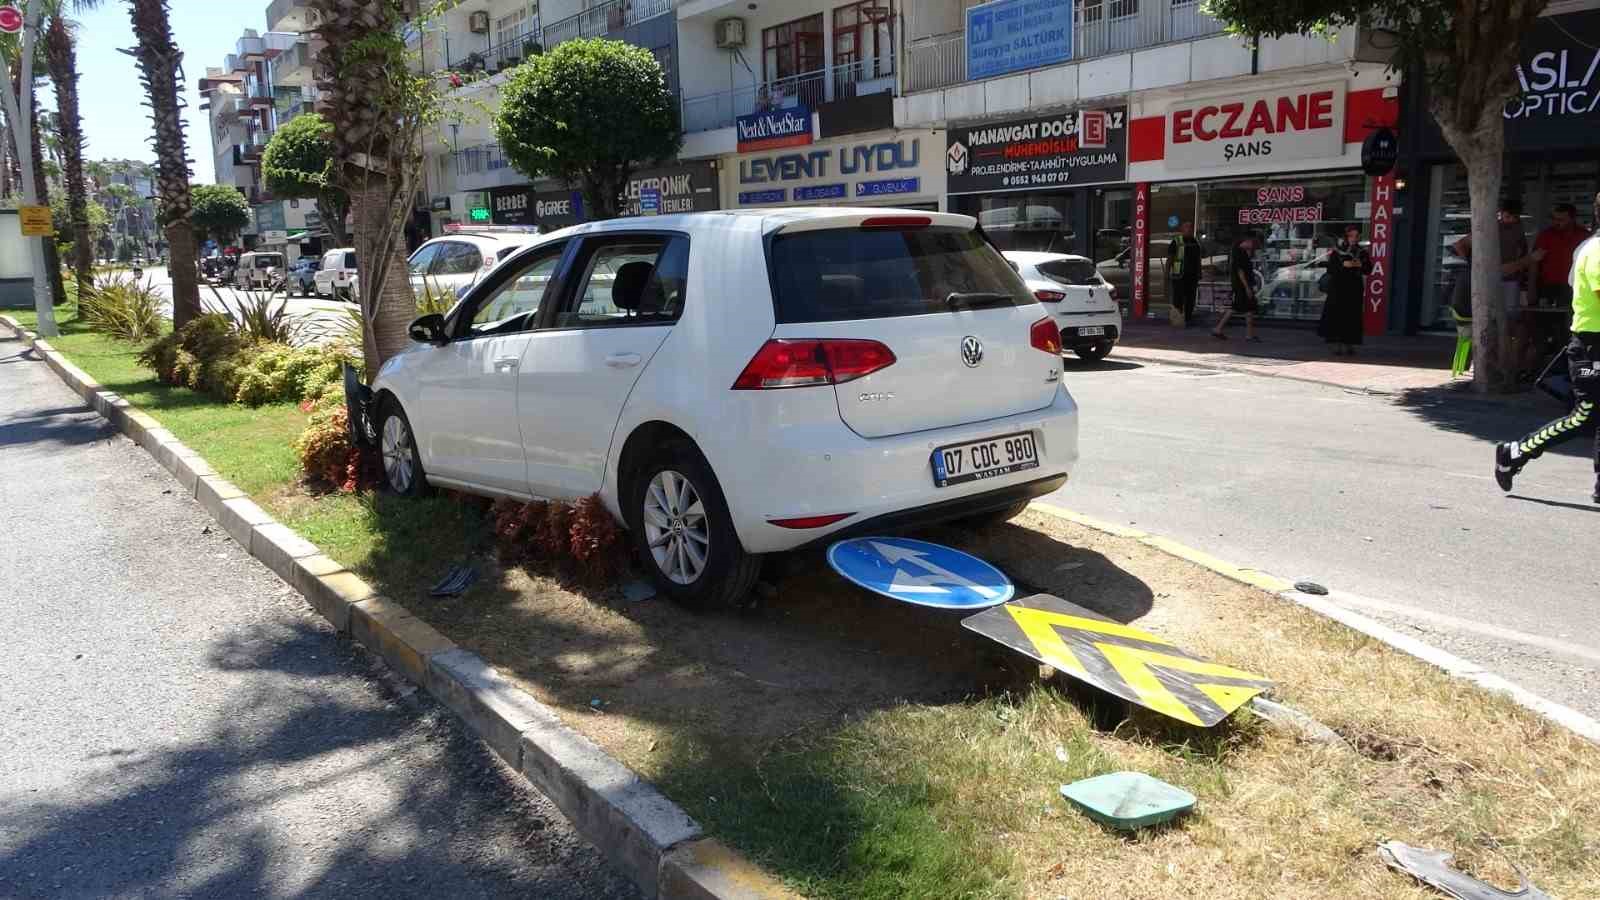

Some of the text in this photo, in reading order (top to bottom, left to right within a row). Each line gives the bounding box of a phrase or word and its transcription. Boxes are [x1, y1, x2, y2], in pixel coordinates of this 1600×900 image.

[1172, 91, 1333, 144] ECZANE
[968, 124, 1039, 146] MANAVGAT
[740, 137, 920, 185] LEVENT UYDU
[1224, 141, 1272, 161] ŞANS
[545, 200, 570, 215] GREE
[1257, 185, 1303, 206] ŞANS
[1239, 203, 1322, 225] ECZANESİ
[1134, 191, 1145, 300] APOTHEKE
[1370, 176, 1389, 313] HARMACY
[944, 437, 1033, 474] 07 CDC 980
